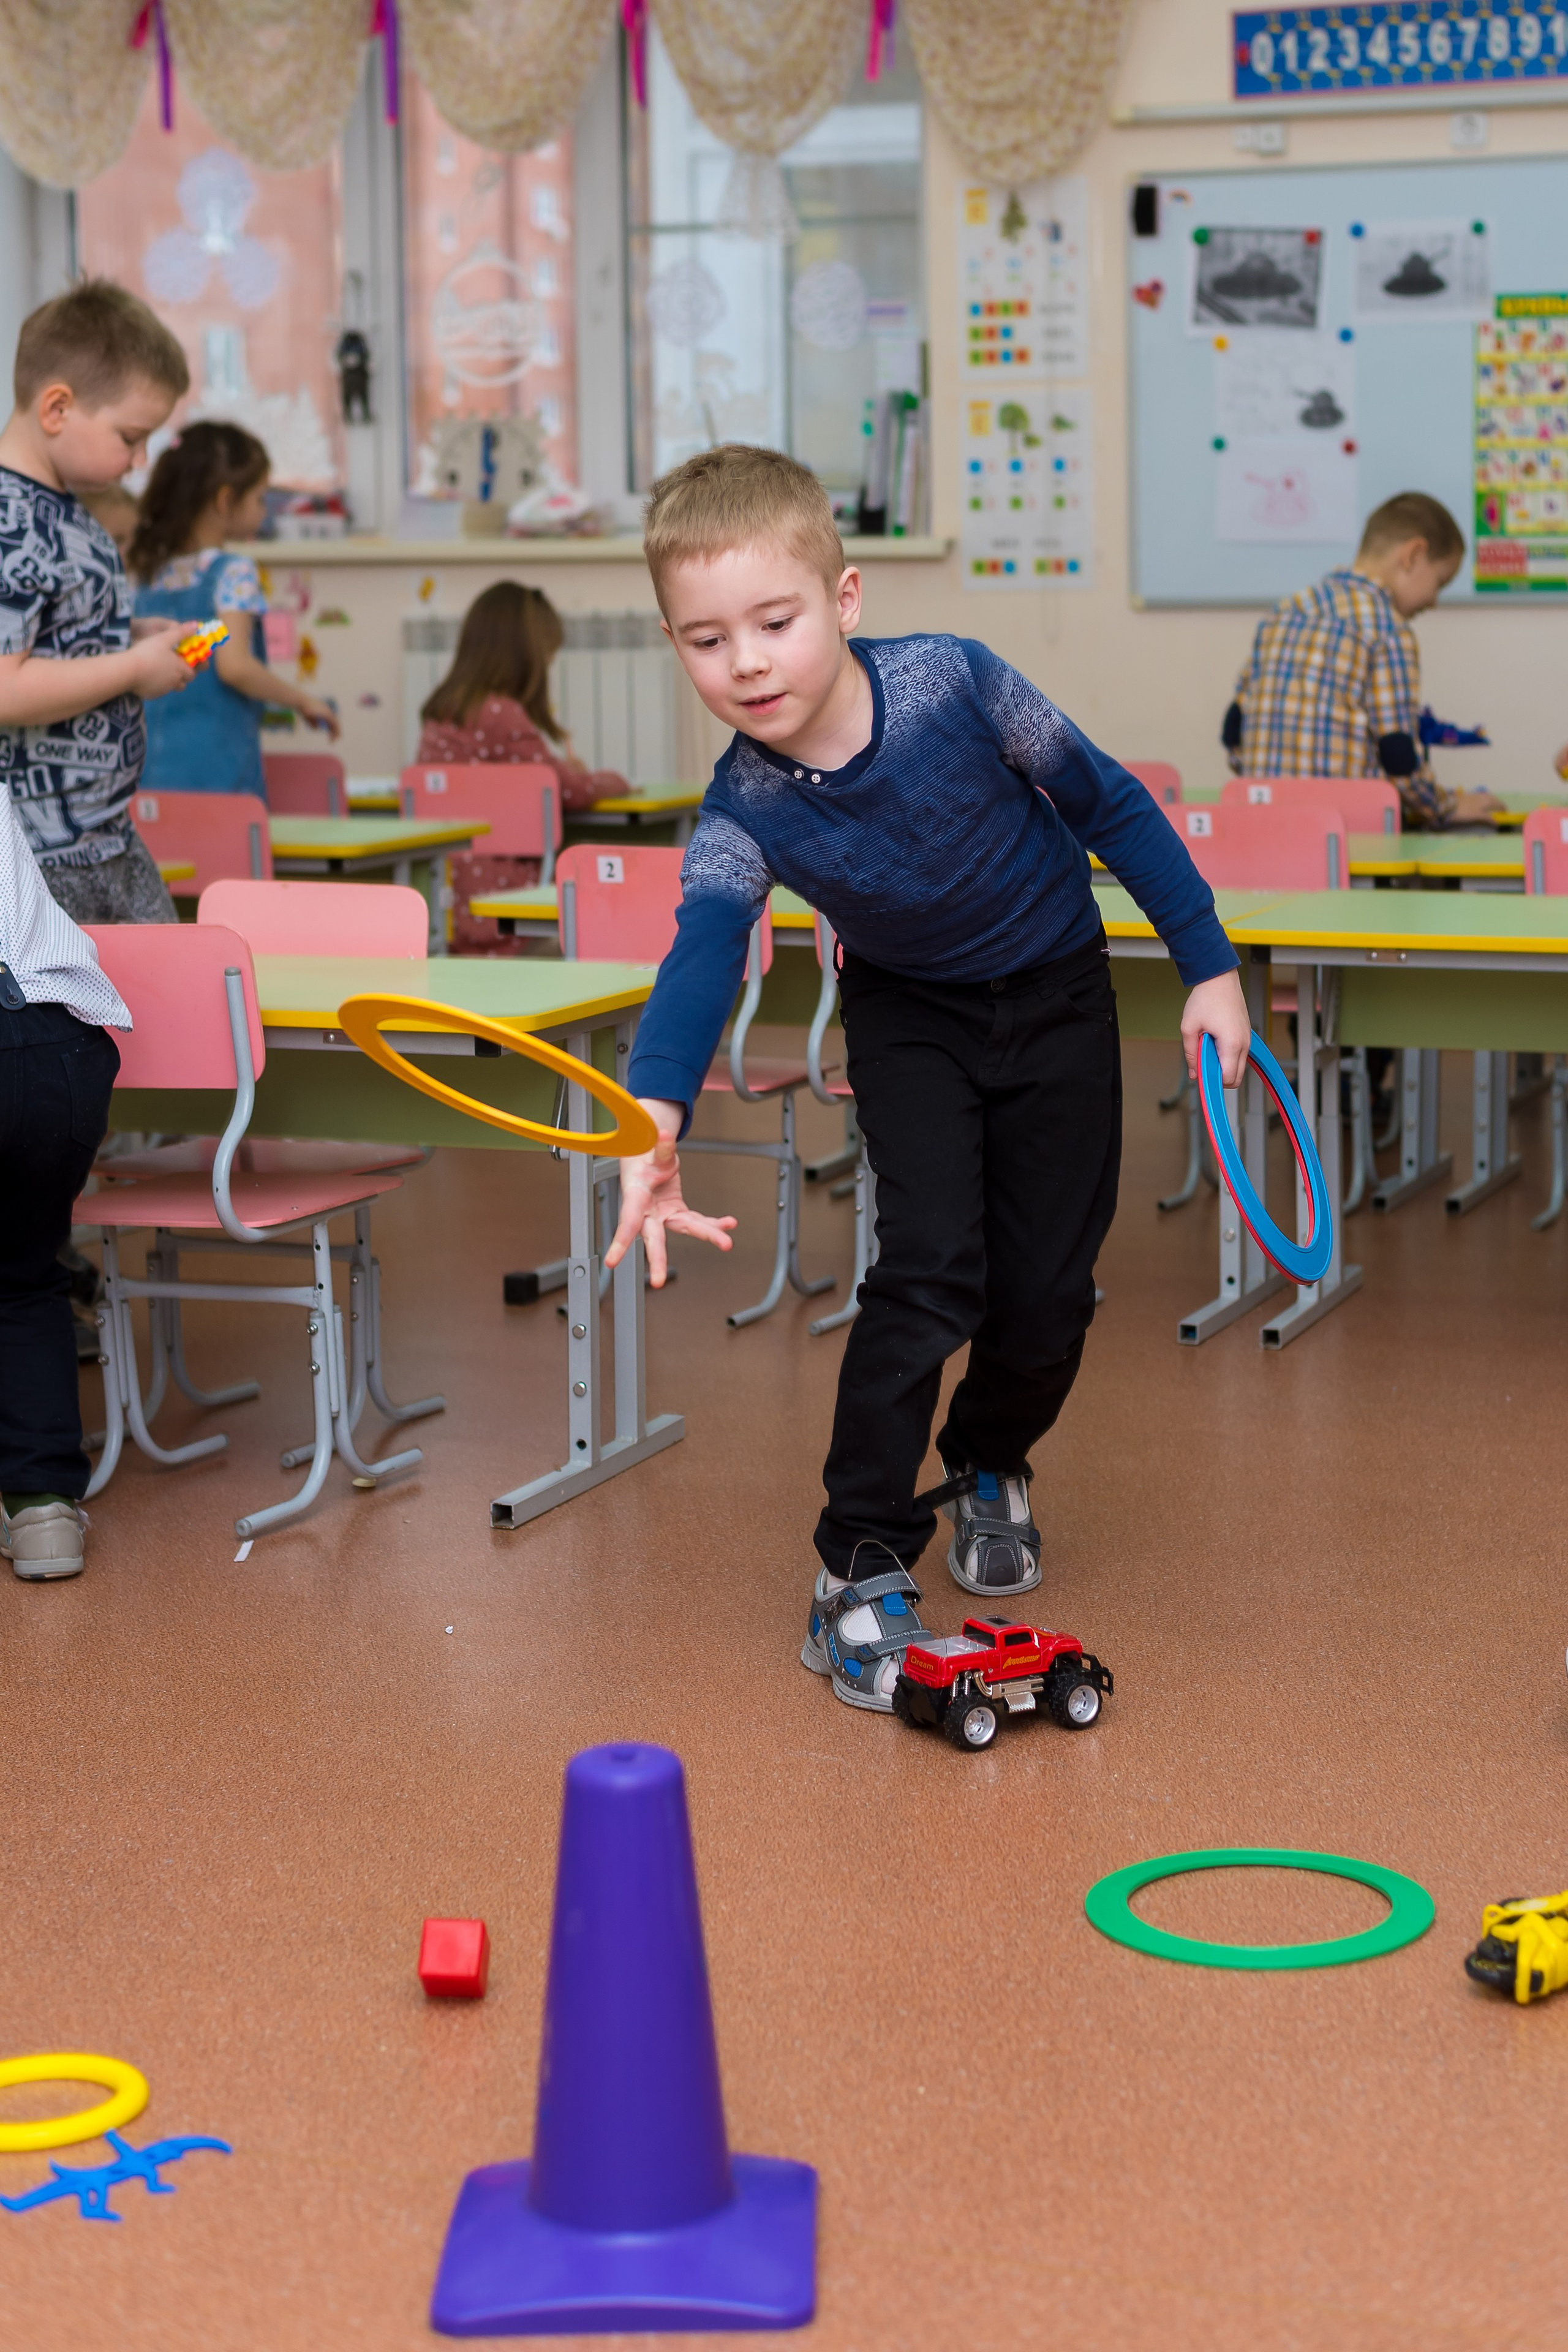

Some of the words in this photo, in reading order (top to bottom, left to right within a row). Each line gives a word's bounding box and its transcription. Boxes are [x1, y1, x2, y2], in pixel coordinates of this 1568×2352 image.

[36, 741, 72, 760] ONE
[77, 745, 113, 763] WAY
[605, 861, 616, 879] 2
[911, 1655, 934, 1672] Dream
